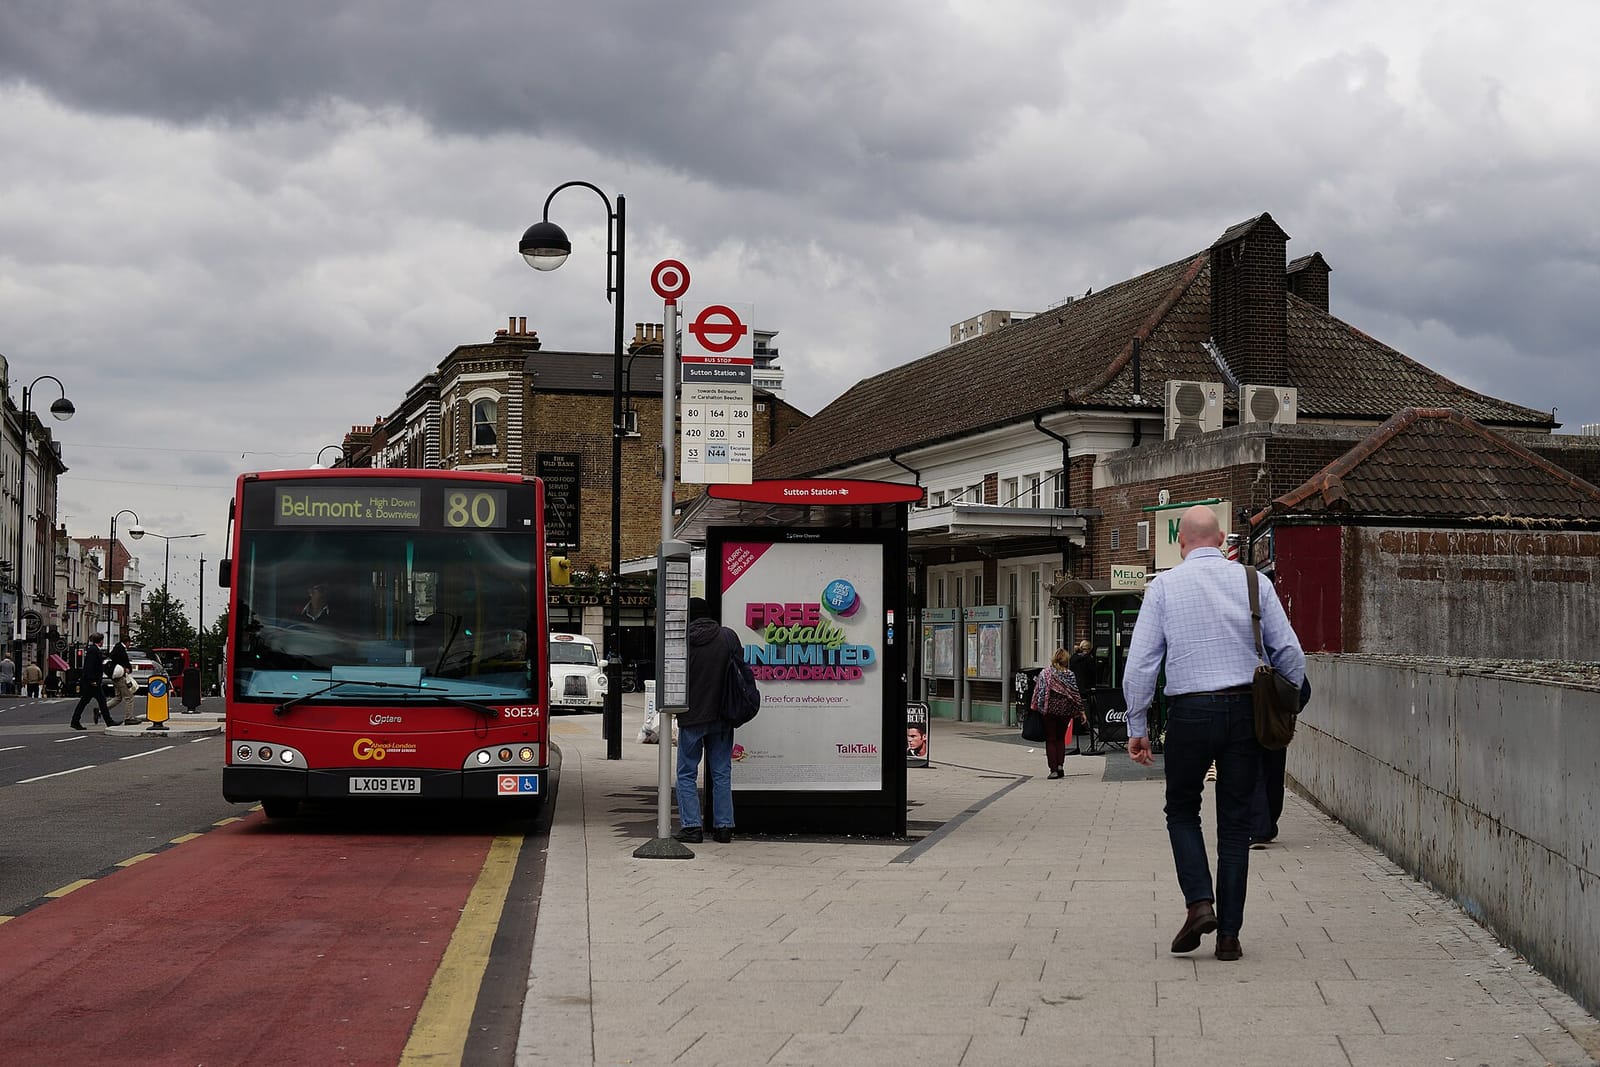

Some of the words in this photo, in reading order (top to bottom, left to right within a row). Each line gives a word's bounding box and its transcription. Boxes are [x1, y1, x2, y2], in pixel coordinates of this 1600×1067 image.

[281, 495, 362, 518] Belmont
[370, 497, 388, 510] High
[391, 498, 415, 507] Down
[366, 509, 373, 518] &
[376, 510, 419, 519] Downview
[447, 492, 496, 528] 80
[725, 546, 743, 565] HURRY
[728, 561, 739, 571] Sale
[738, 550, 750, 562] ends
[732, 565, 743, 576] 18th
[742, 554, 755, 567] June
[1113, 570, 1144, 579] MELO
[832, 598, 844, 606] BT
[745, 602, 820, 628] FREE
[764, 620, 846, 649] totally
[750, 666, 863, 680] BROADBAND
[373, 714, 402, 724] Optare
[504, 707, 539, 717] SOE34
[353, 738, 386, 760] Go
[836, 744, 878, 754] TalkTalk
[354, 779, 388, 790] LX09
[391, 779, 415, 790] EVB
